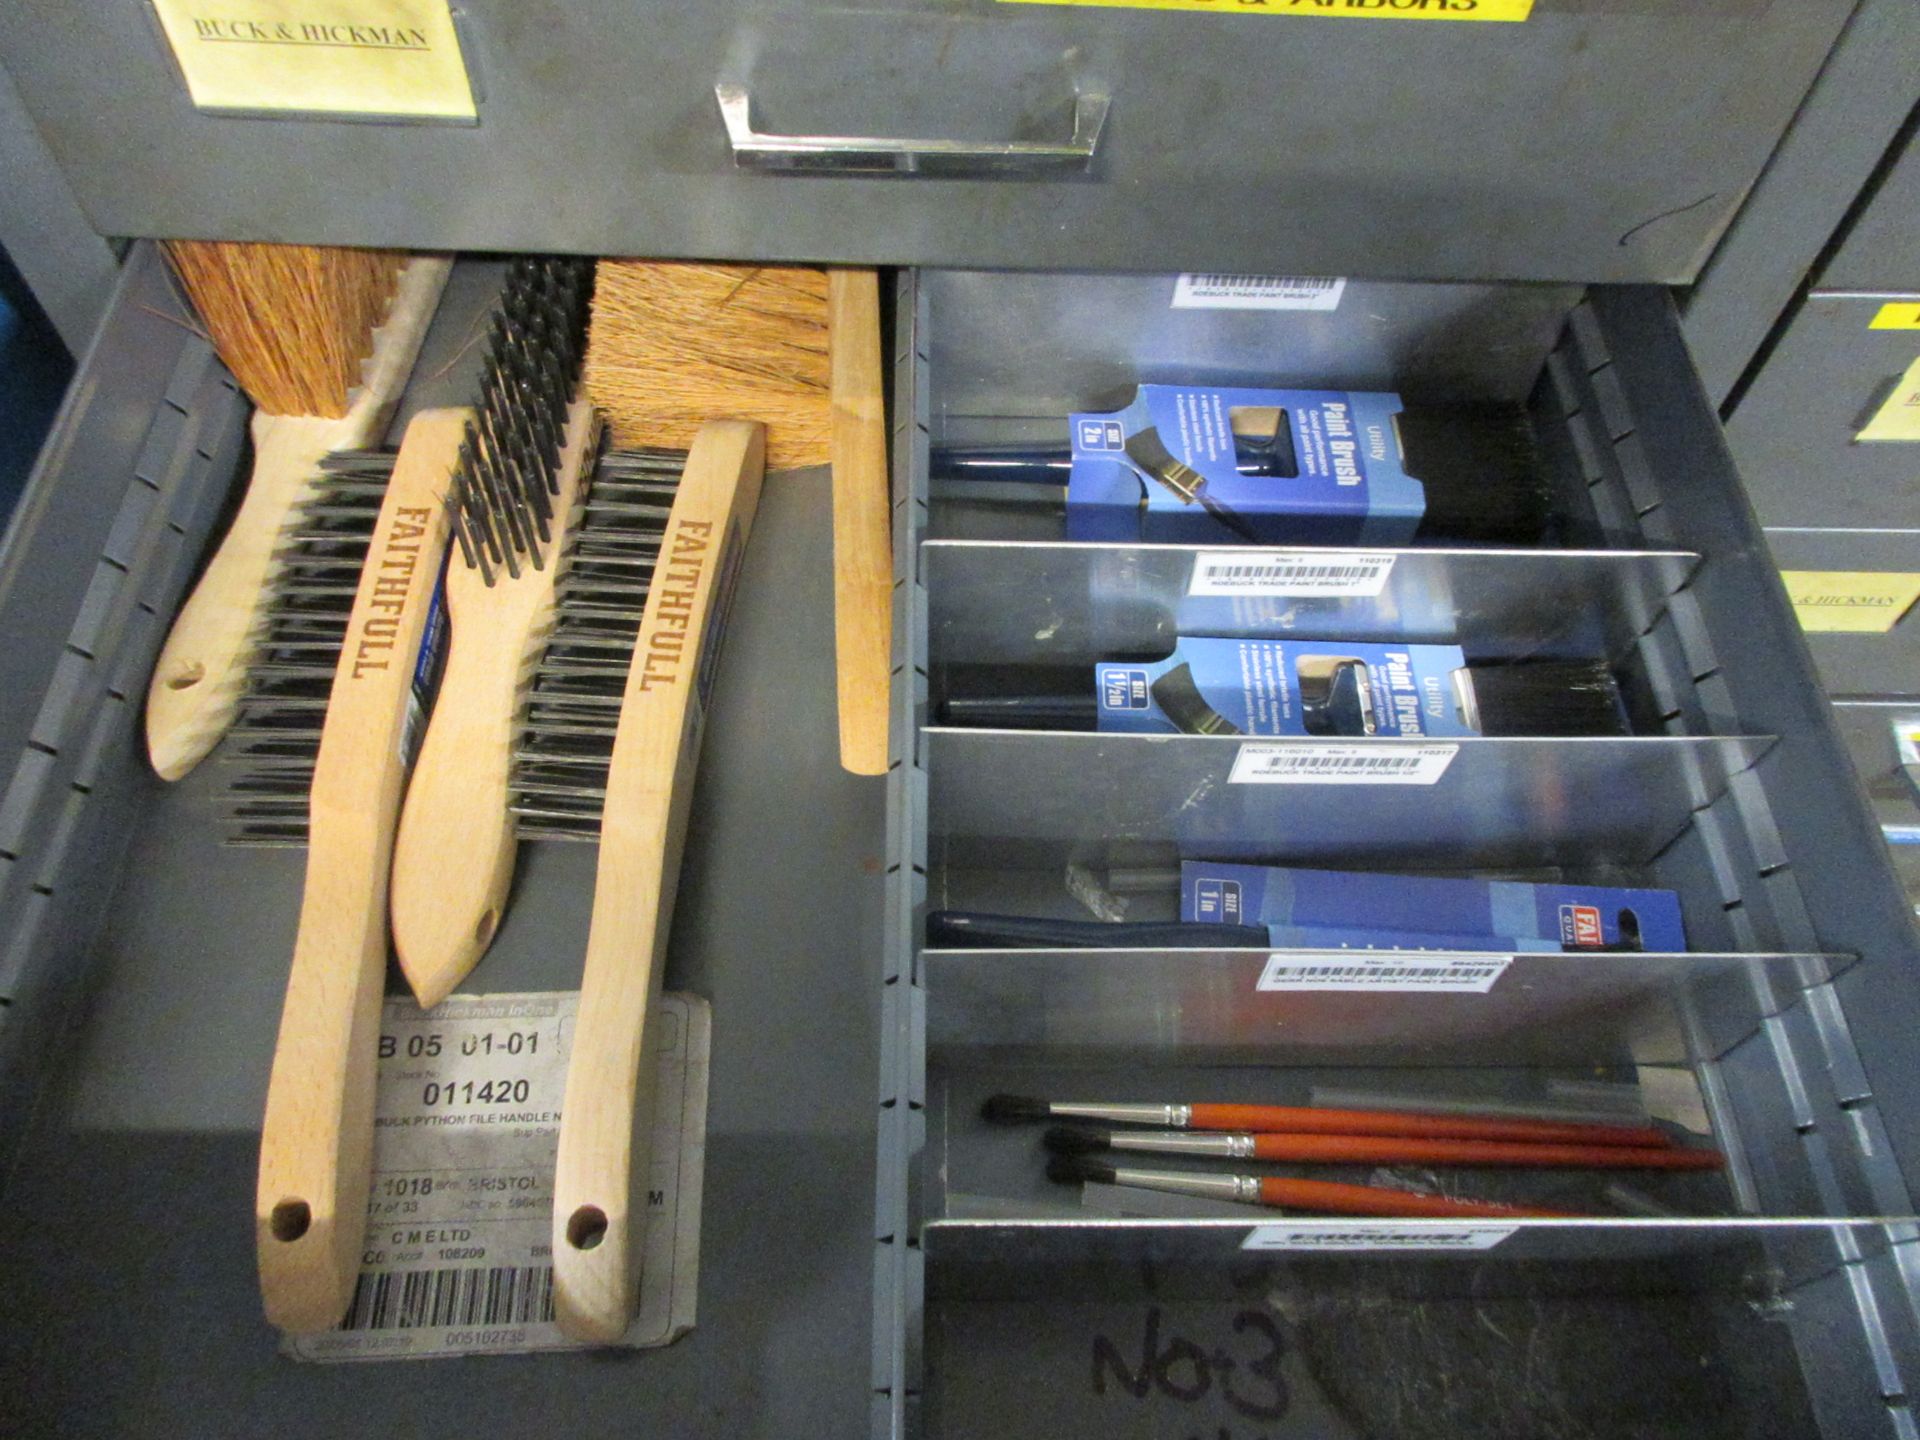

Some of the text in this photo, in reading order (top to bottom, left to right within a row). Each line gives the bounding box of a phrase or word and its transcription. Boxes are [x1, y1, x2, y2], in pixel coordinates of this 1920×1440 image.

[194, 18, 428, 46] BUCK & HICKMAN
[1321, 403, 1362, 486] Paint Brush
[1367, 426, 1386, 461] Utility
[352, 506, 433, 680] FAITHFULL
[639, 518, 714, 692] FAITHFULL
[1816, 595, 1895, 606] HICKMAN
[1384, 652, 1416, 691] Paint
[1132, 680, 1145, 699] SIZE
[1423, 676, 1445, 717] Utility
[1224, 893, 1237, 912] SIZE
[408, 1034, 443, 1058] 05
[460, 1031, 540, 1056] 01-01
[422, 1079, 531, 1106] 011420
[413, 1115, 467, 1127] PYTHON
[469, 1113, 497, 1125] FILE
[500, 1112, 549, 1124] HANDLE
[384, 1178, 433, 1196] 1018
